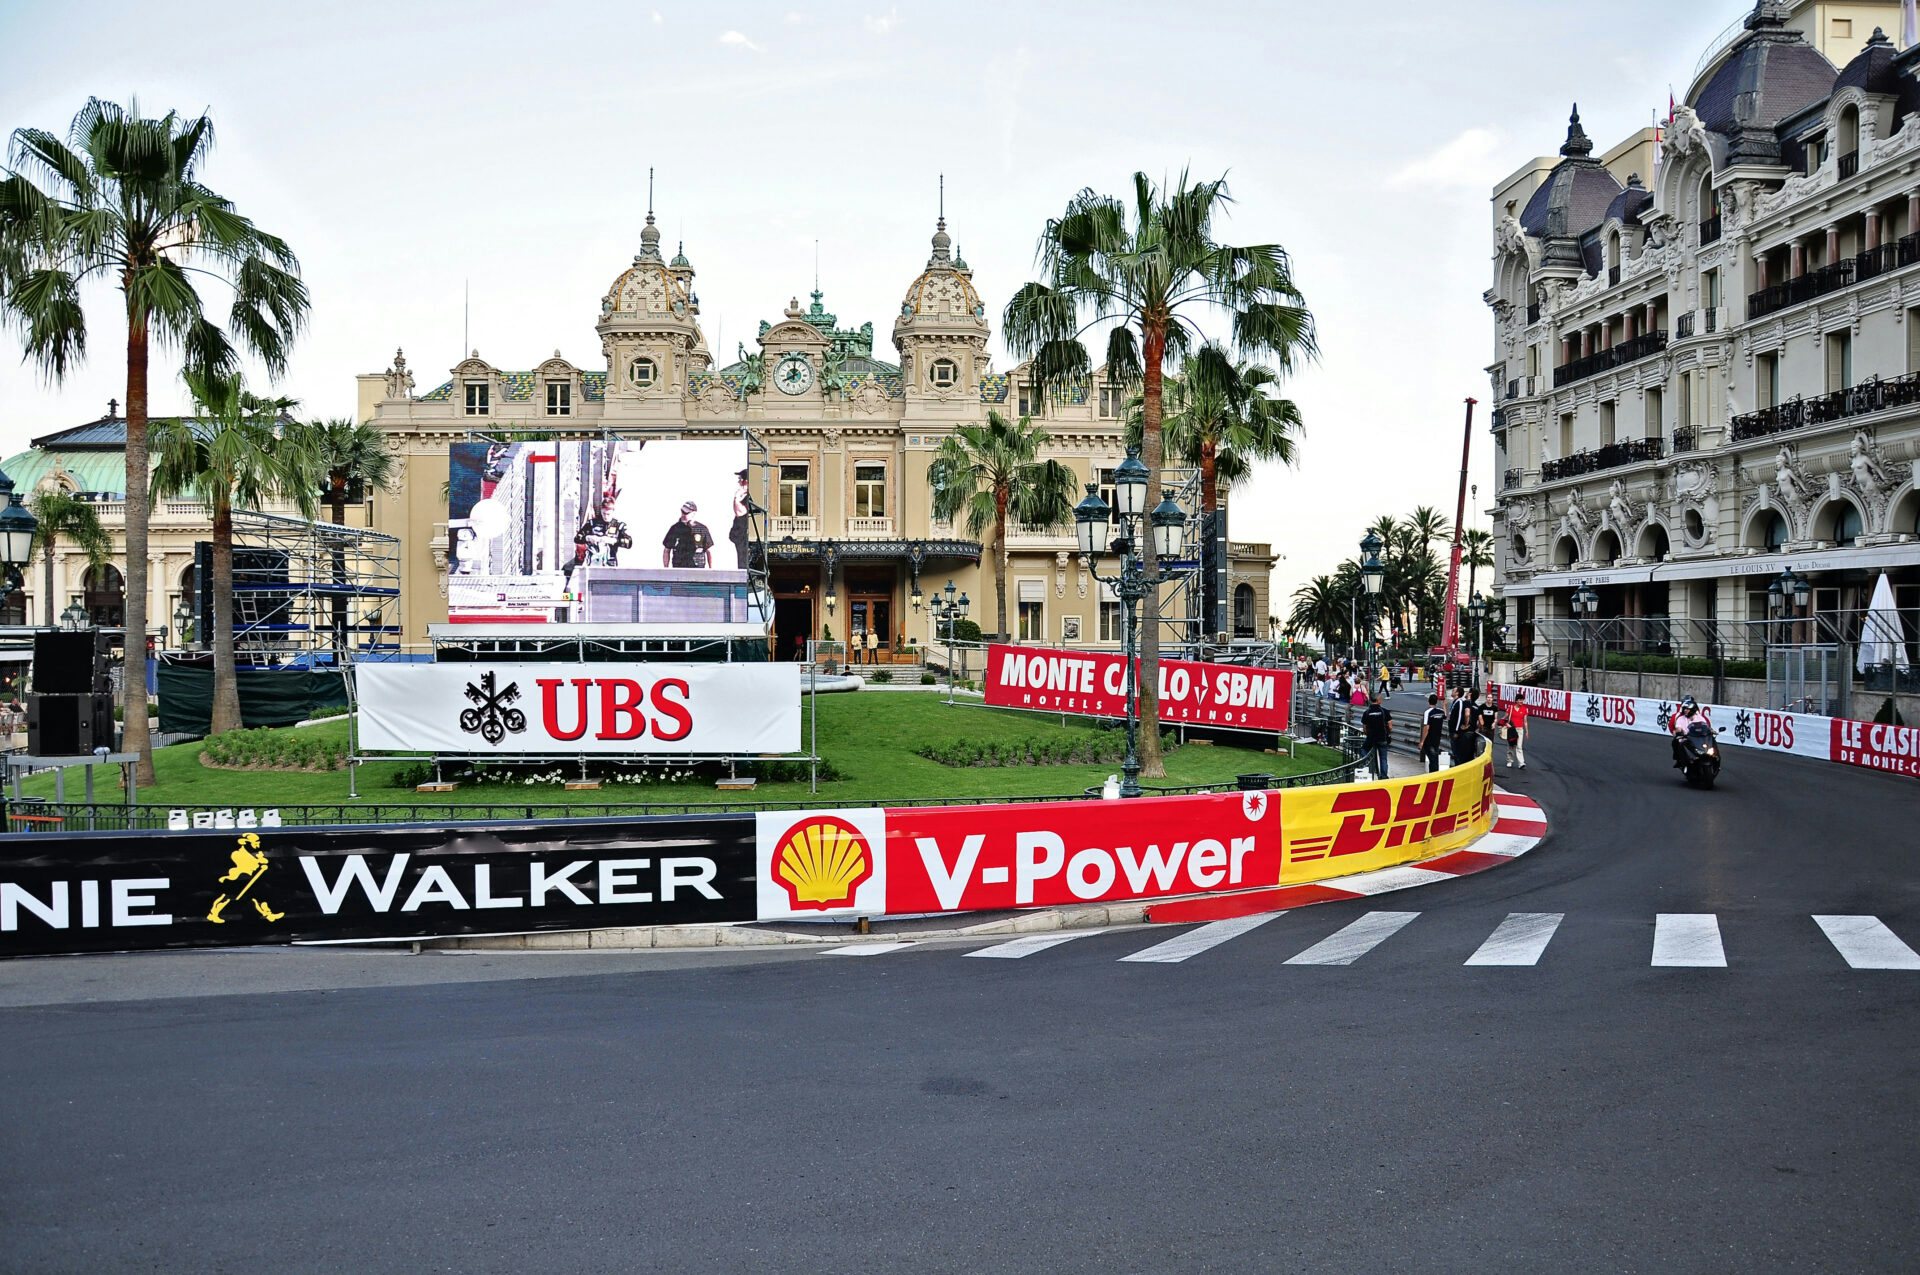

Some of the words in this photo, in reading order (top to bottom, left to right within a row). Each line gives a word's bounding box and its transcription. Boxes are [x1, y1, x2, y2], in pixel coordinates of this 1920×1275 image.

[1730, 566, 1739, 574] LE
[1741, 564, 1763, 573] LOUIS
[1765, 563, 1776, 572] XV
[1000, 653, 1096, 694] MONTE
[1103, 662, 1191, 701] CALO
[1215, 671, 1275, 709] SBM
[1548, 689, 1566, 711] SBM
[535, 677, 694, 742] UBS
[1023, 693, 1103, 710] HOTELS
[1165, 706, 1248, 723] ASINOS
[1602, 696, 1636, 726] UBS
[1754, 712, 1795, 749] UBS
[1841, 720, 1862, 749] LE
[1870, 724, 1920, 758] CASI
[1841, 750, 1855, 763] DE
[1862, 753, 1920, 775] MONTE-C
[1328, 777, 1458, 858] DHL
[298, 853, 725, 914] WALKER
[914, 830, 1256, 911] V-Power
[0, 880, 173, 932] NIE
